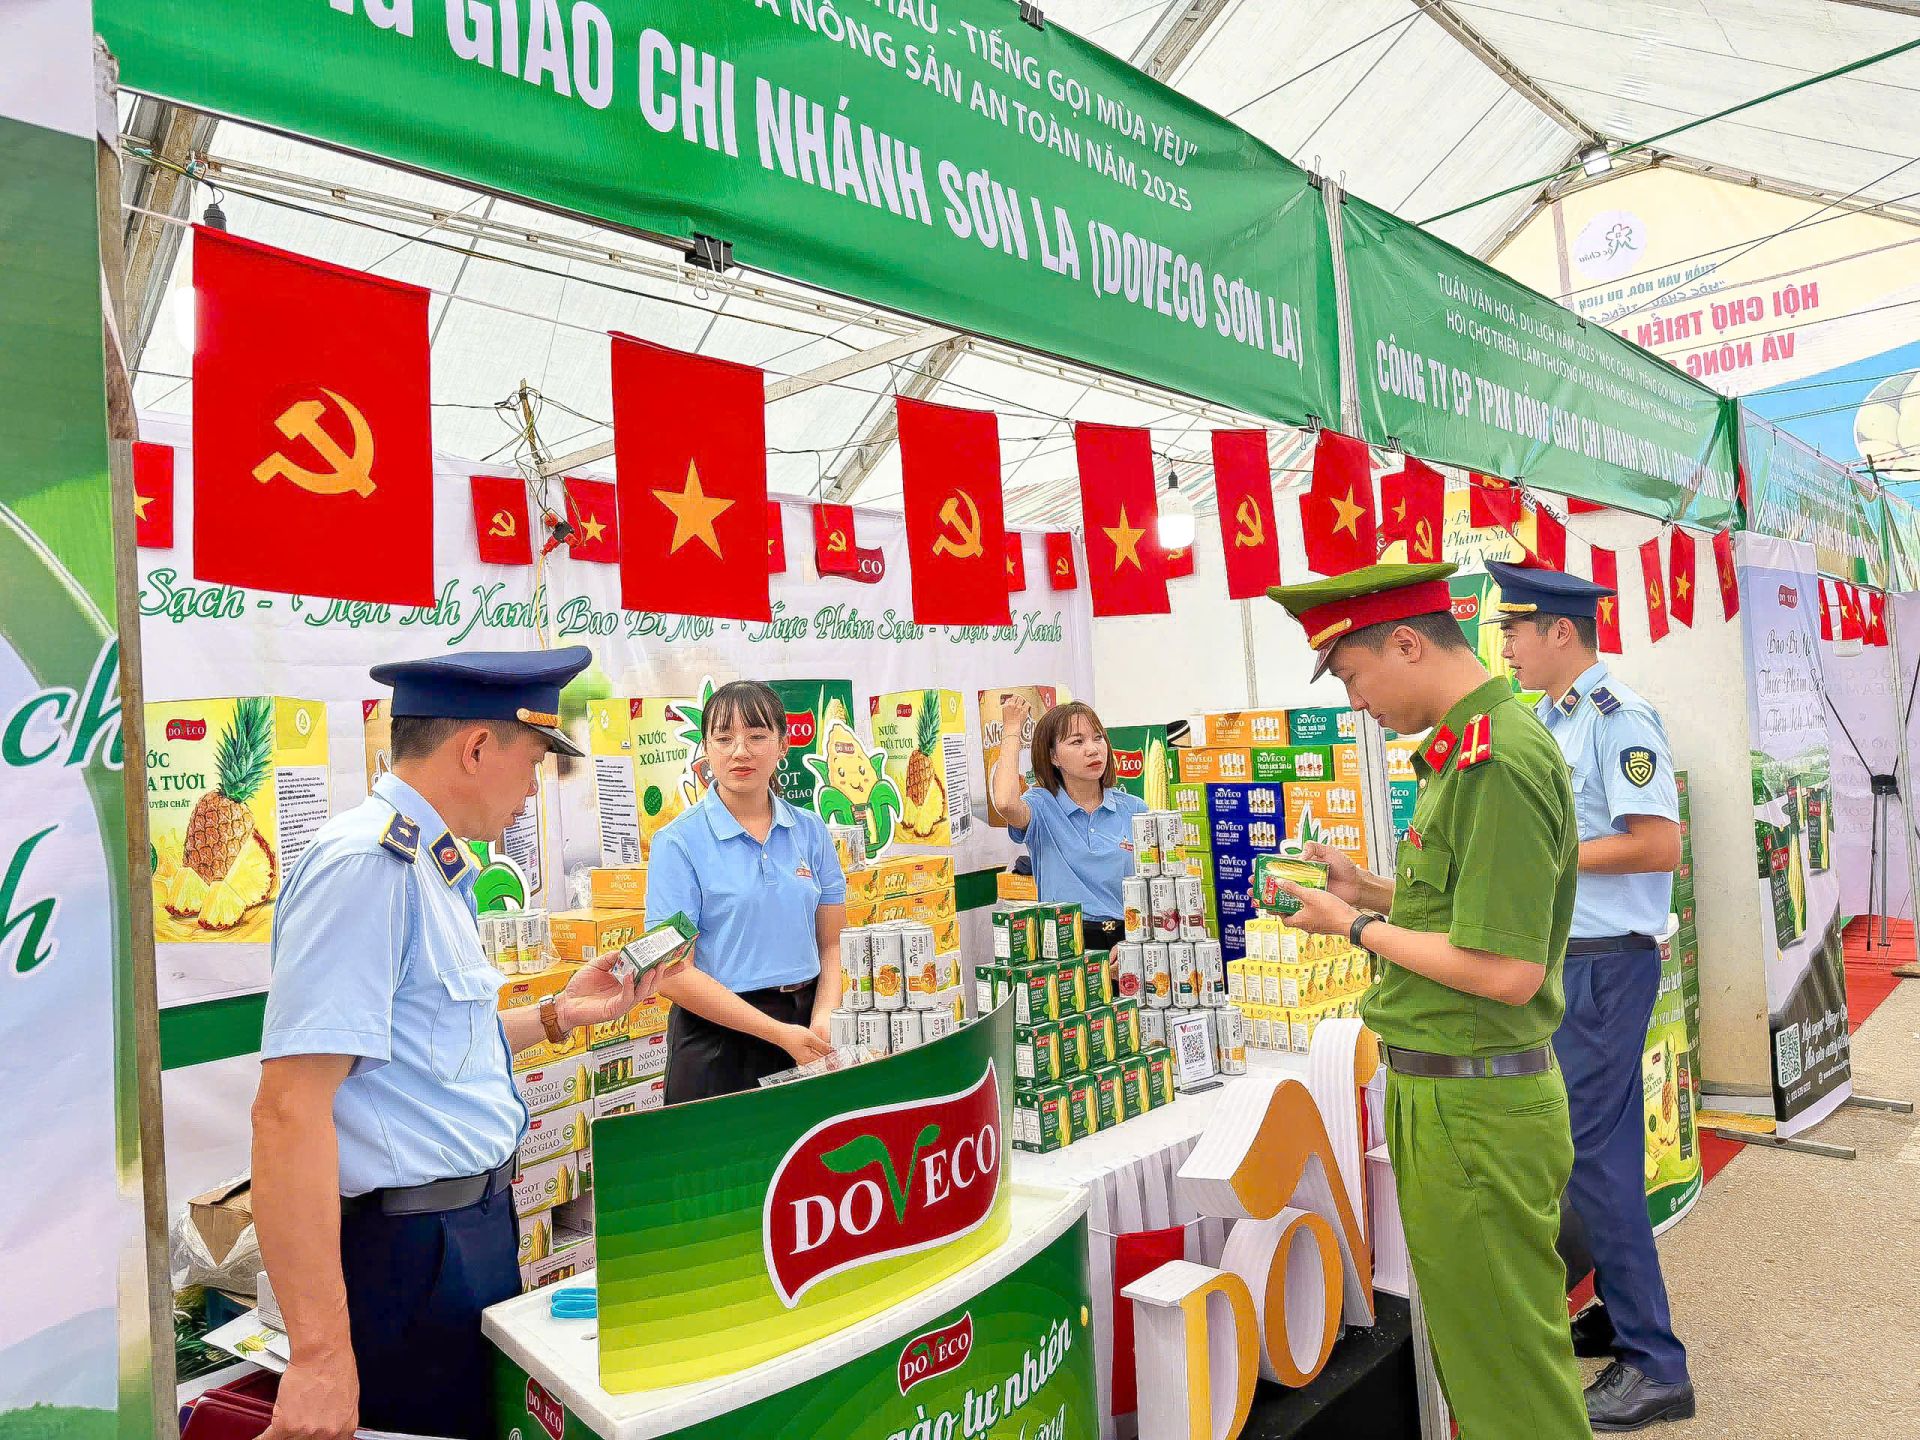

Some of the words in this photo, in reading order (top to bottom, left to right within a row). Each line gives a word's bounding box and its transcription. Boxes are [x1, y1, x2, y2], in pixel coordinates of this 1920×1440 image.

[959, 19, 1040, 89] TIẾNG
[1047, 70, 1090, 120] GỌI
[1097, 93, 1146, 145] MÙA
[790, 0, 896, 68] NÔNG
[904, 44, 961, 104] SẢN
[970, 80, 1008, 127] AN
[1011, 100, 1082, 163] TOÀN
[1086, 138, 1137, 192] NĂM
[1142, 168, 1192, 212] 2025
[445, 0, 613, 109] GIAO
[638, 27, 739, 158] CHI
[755, 76, 933, 226] NHÁNH
[937, 159, 1029, 262] SƠN
[1030, 197, 1080, 280] LA
[1087, 219, 1207, 329] (DOVECO
[1213, 272, 1265, 351] SƠN
[1267, 296, 1303, 372] LA)
[1437, 271, 1469, 305] TUẦN
[1470, 288, 1492, 317] VĂN
[1520, 312, 1533, 335] DU
[1535, 319, 1555, 343] LỊCH
[1556, 330, 1575, 354] NĂM
[1446, 309, 1467, 339] HỘI
[1469, 320, 1491, 351] CHỢ
[1491, 329, 1520, 358] TRIỂN
[1521, 343, 1540, 368] LÃM
[1540, 351, 1578, 383] THƯƠNG
[1376, 333, 1426, 403] CÔNG
[1428, 358, 1447, 411] TY
[1451, 368, 1472, 417] CP
[1475, 376, 1513, 432] TPXK
[1552, 405, 1579, 454] GIAO
[1582, 416, 1600, 460] CHI
[1602, 422, 1639, 472] NHÁNH
[137, 568, 245, 623] Sạch
[447, 582, 549, 646] Xanh
[1451, 603, 1476, 615] ECO
[556, 595, 619, 638] Bao
[1014, 611, 1062, 654] Xanh
[1297, 713, 1327, 724] DOVECO
[786, 723, 812, 737] ECO
[638, 729, 667, 747] NƯỚC
[639, 751, 665, 766] XOÀI
[1185, 752, 1213, 763] DOVECO
[1257, 752, 1286, 763] DOVECO
[1341, 749, 1358, 760] DOV
[1630, 751, 1649, 759] DMS
[1114, 755, 1142, 771] VECO
[161, 774, 206, 791] TƯƠI
[778, 771, 801, 790] ỌT
[786, 788, 813, 800] GIAO
[1215, 788, 1241, 798] DOVECO
[149, 799, 169, 810] UYÊN
[1216, 820, 1243, 831] DOVECO
[1219, 855, 1246, 866] DOVECO
[1222, 890, 1249, 901] DOVECO
[1225, 924, 1245, 934] DOVE
[656, 1046, 667, 1055] NG
[520, 1086, 533, 1099] GÔ
[527, 1098, 539, 1108] NG
[520, 1134, 532, 1147] GÔ
[788, 1123, 997, 1256] DOVECO
[582, 1257, 594, 1268] NG
[903, 1332, 970, 1381] DOVECO
[963, 1385, 1000, 1440] tự
[1004, 1317, 1073, 1417] nhiên
